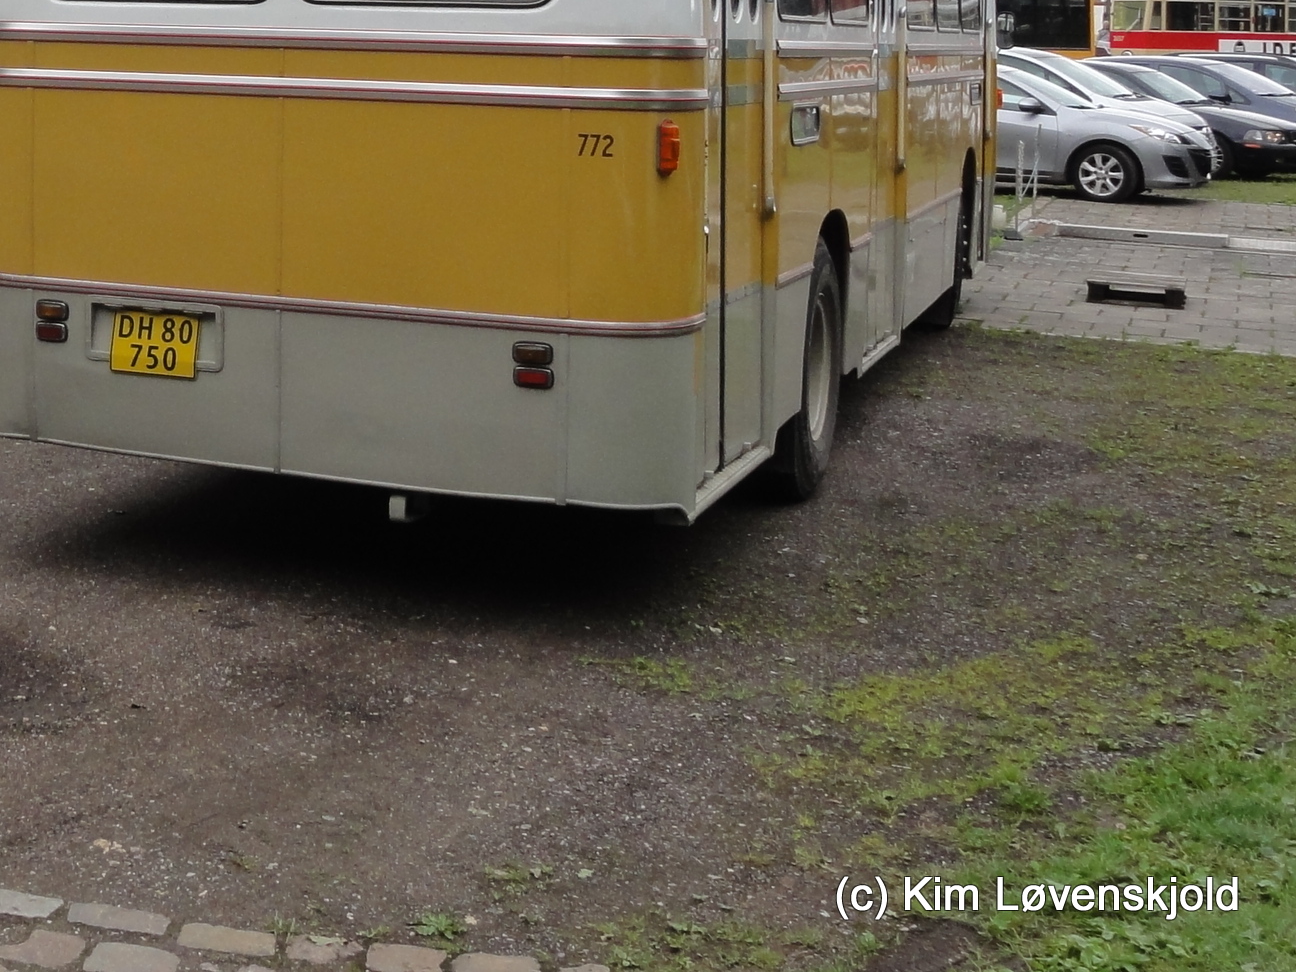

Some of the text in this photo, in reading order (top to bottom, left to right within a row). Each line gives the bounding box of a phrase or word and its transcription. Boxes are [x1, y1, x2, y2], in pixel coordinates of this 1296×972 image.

[578, 133, 614, 158] 772
[118, 315, 193, 345] DH 80
[130, 344, 177, 372] 750
